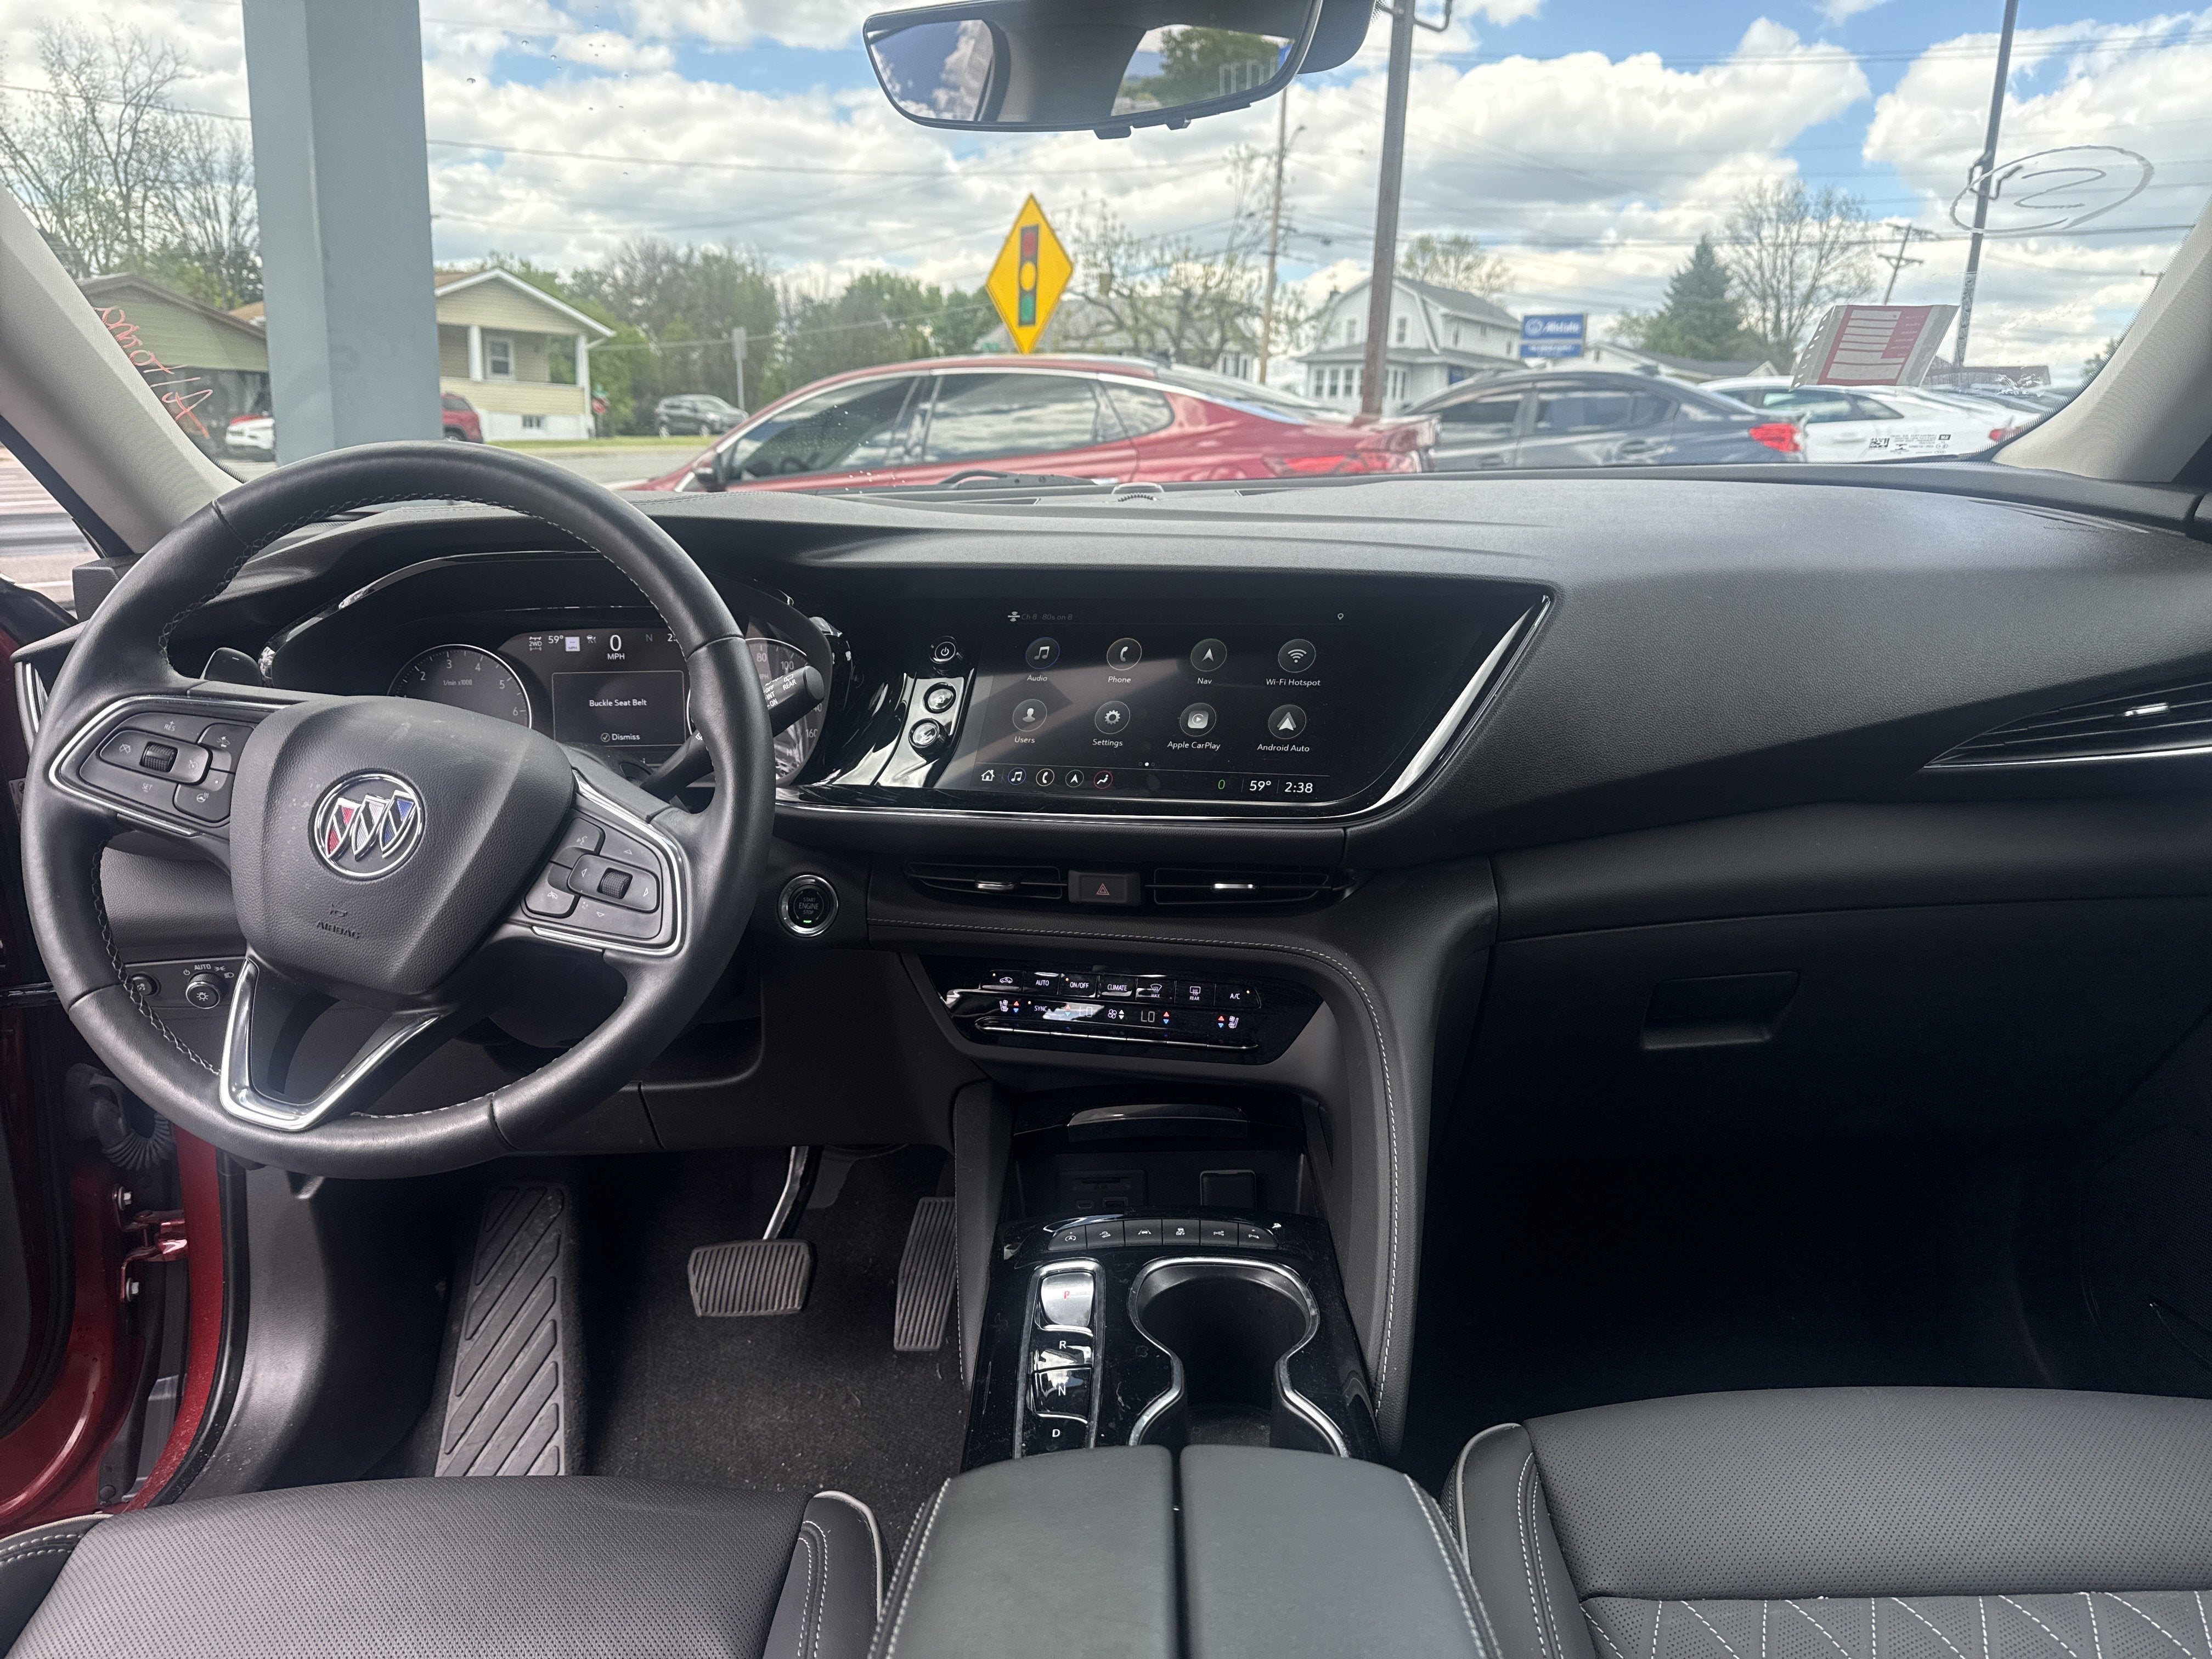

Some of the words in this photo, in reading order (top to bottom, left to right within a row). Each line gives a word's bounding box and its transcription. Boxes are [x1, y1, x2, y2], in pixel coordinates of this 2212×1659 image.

[548, 635, 564, 644] 59°
[645, 634, 653, 642] N
[609, 634, 622, 652] 0
[757, 653, 768, 662] 80
[447, 659, 453, 669] 3
[475, 662, 481, 672] 4
[780, 661, 794, 670] 100
[420, 671, 426, 681] 2
[1107, 675, 1131, 684] Phone
[499, 680, 505, 689] 5
[782, 679, 797, 691] REAR
[1288, 679, 1321, 687] Hotspot
[765, 684, 775, 693] OFF
[766, 691, 775, 700] INT
[589, 698, 613, 707] Buckle
[769, 698, 778, 707] ON
[512, 707, 518, 716] 6
[164, 724, 176, 732] RES
[1092, 738, 1124, 748] Settings
[1167, 741, 1189, 750] Apple
[1191, 741, 1221, 752] CarPlay
[1256, 743, 1289, 752] Android
[142, 782, 153, 791] SET
[1249, 780, 1272, 791] 59°
[1284, 782, 1313, 793] 2:38
[1141, 1011, 1155, 1022] LO
[1059, 1340, 1066, 1349] R
[1058, 1385, 1066, 1396] N
[1052, 1429, 1060, 1437] D
